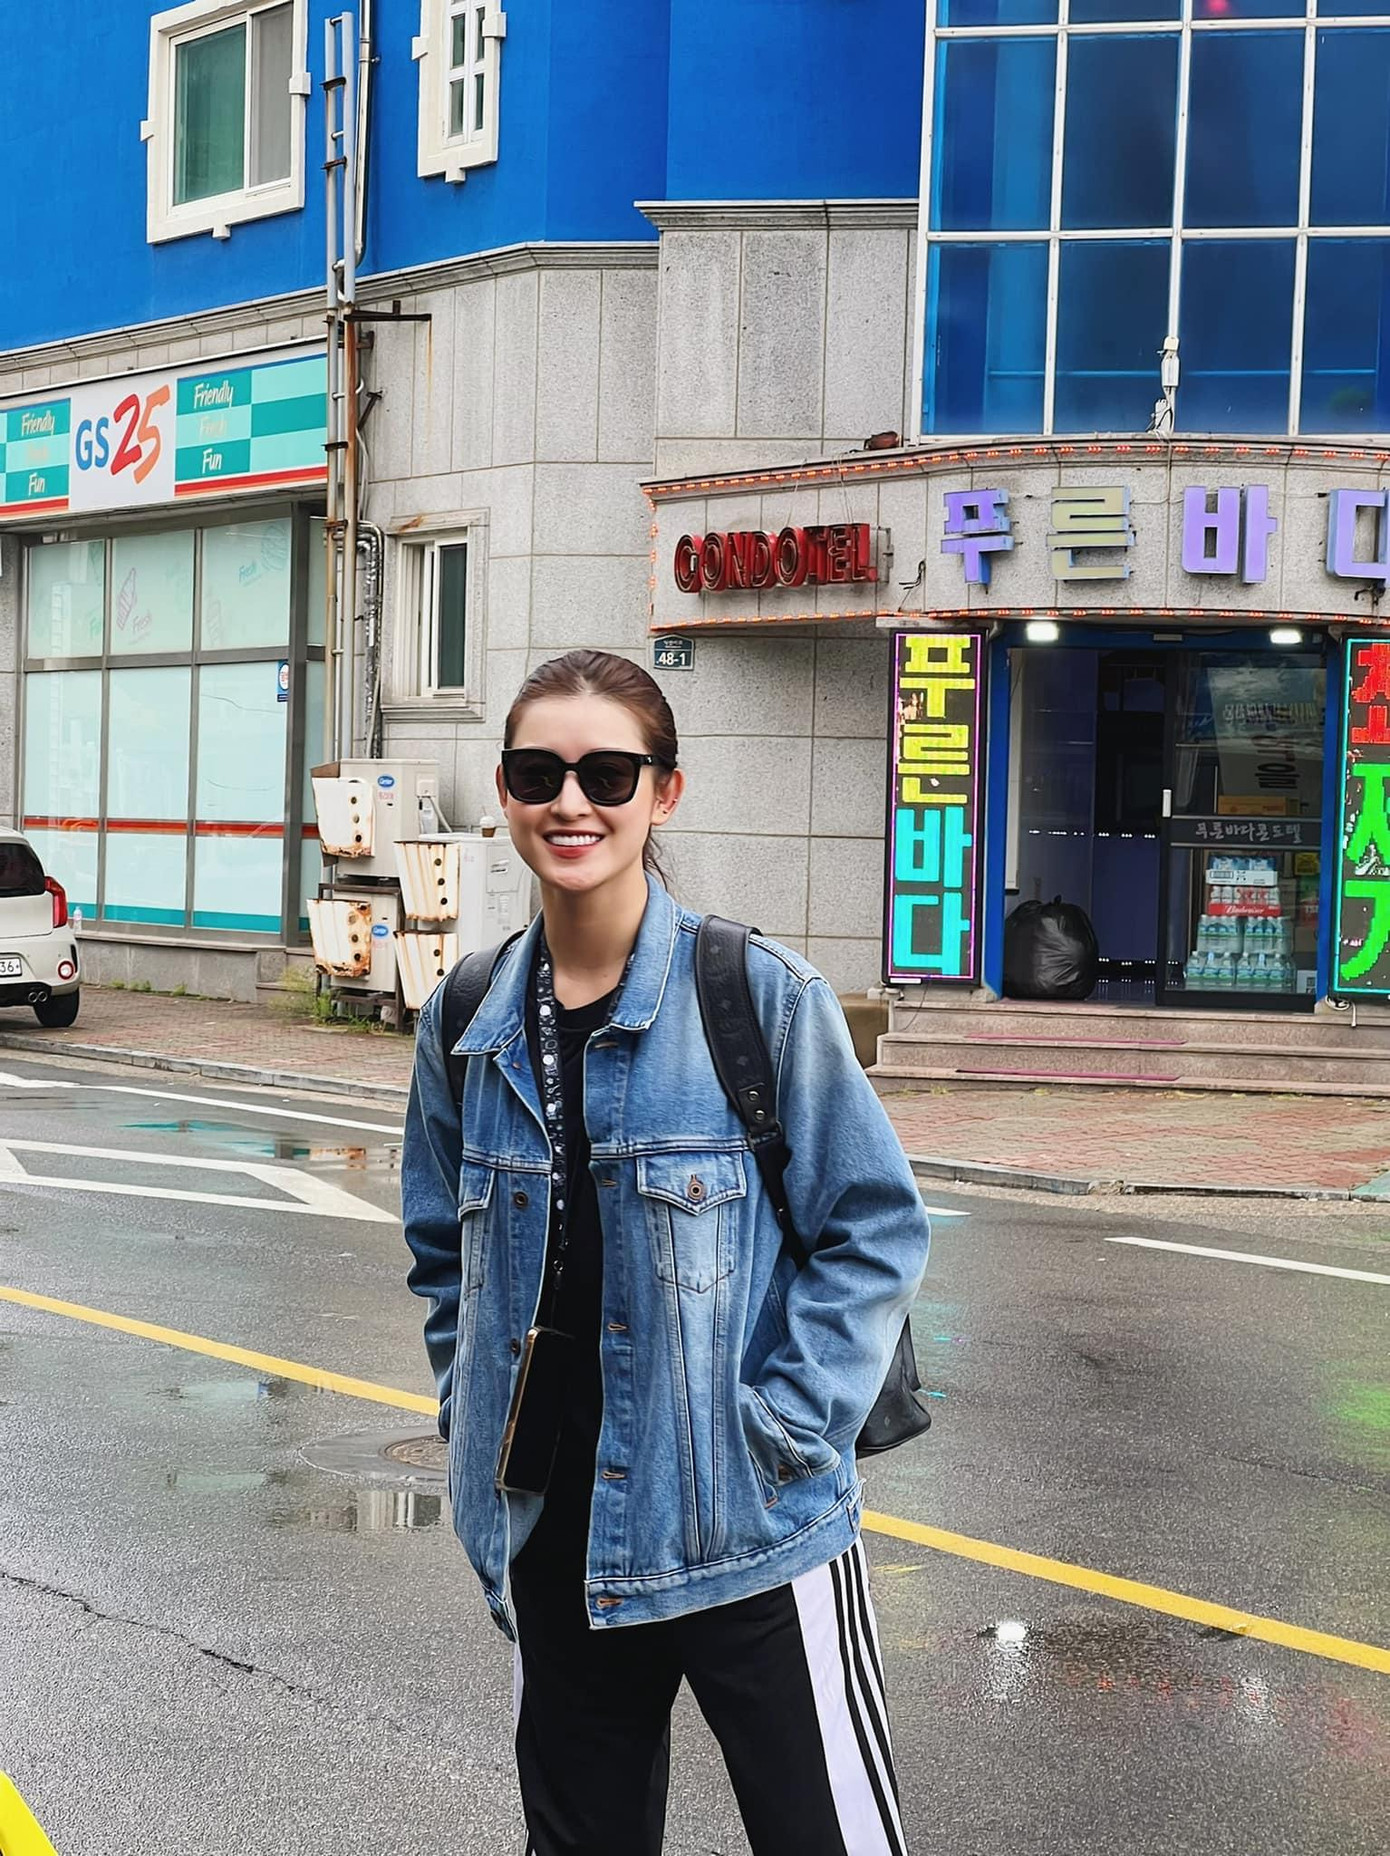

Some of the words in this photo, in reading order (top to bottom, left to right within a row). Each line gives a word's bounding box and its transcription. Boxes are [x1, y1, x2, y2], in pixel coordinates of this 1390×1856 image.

[193, 380, 235, 409] Friendly
[21, 410, 56, 436] Friendly
[75, 384, 171, 484] GS25
[202, 448, 222, 474] Fun
[28, 472, 46, 496] Fun
[674, 523, 878, 593] CONDOTEL
[658, 652, 686, 666] 48-1
